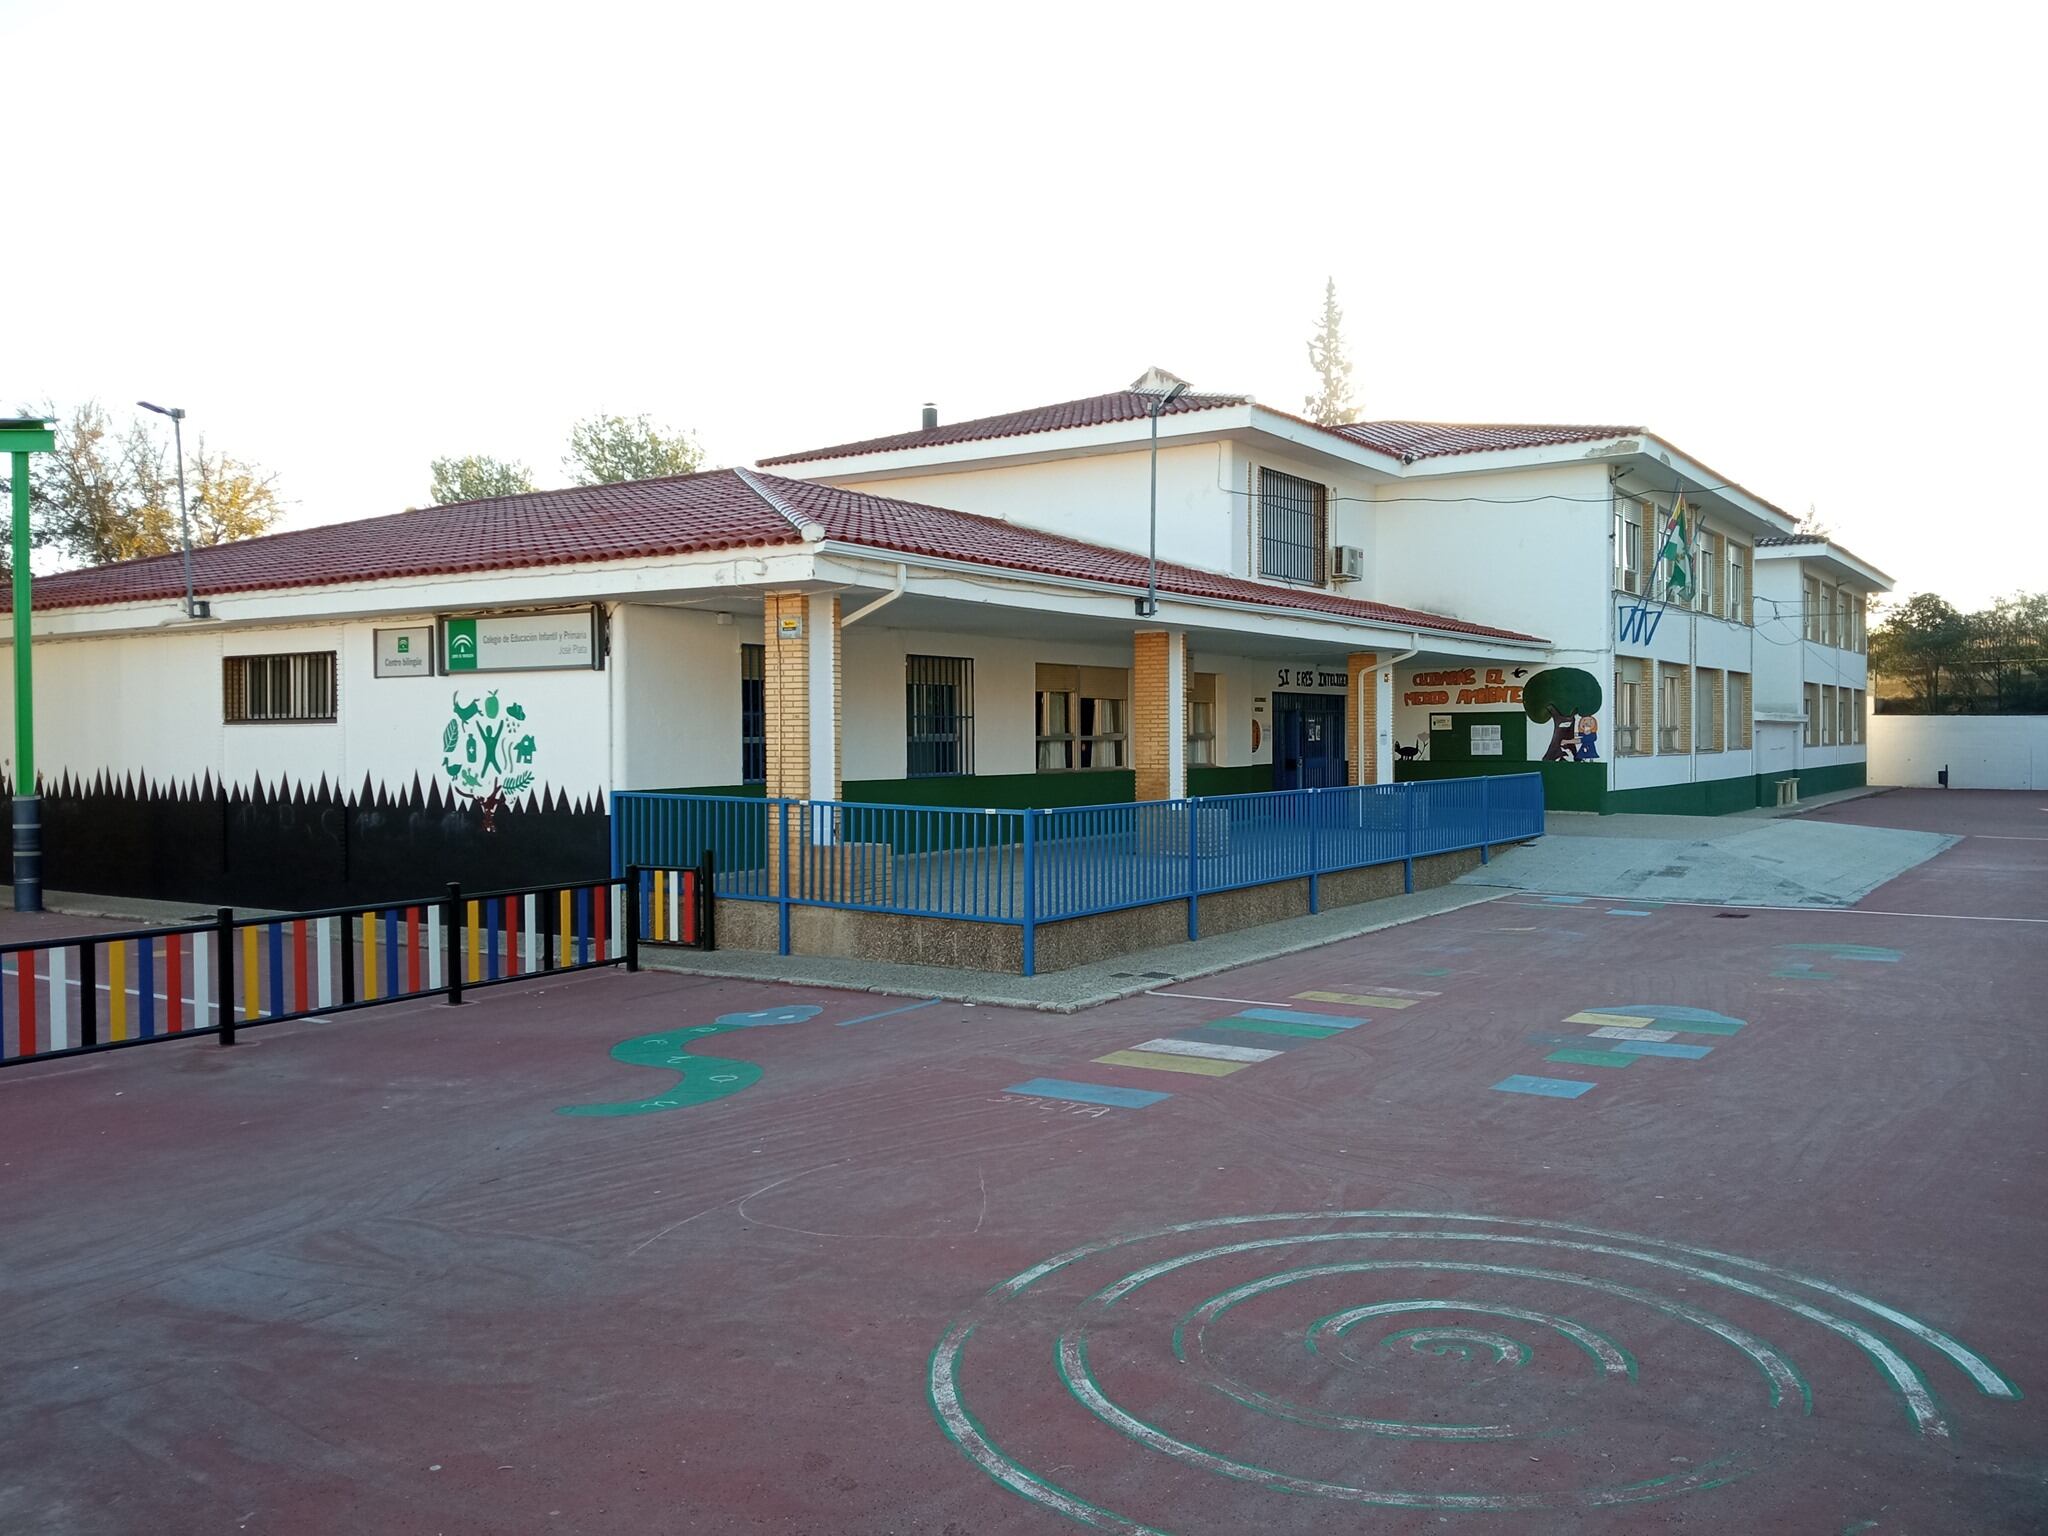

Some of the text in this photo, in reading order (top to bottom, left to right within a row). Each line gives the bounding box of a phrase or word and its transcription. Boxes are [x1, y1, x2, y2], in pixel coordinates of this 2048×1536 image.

[483, 635, 501, 645] Colegio
[503, 634, 510, 643] de
[510, 632, 538, 643] Educación
[539, 631, 558, 641] Infantil
[564, 630, 587, 640] Primaria
[384, 658, 401, 667] Centro
[1278, 669, 1290, 687] SI
[1296, 671, 1314, 687] ERES
[1485, 669, 1505, 685] EL
[1404, 691, 1449, 707] MEDIO
